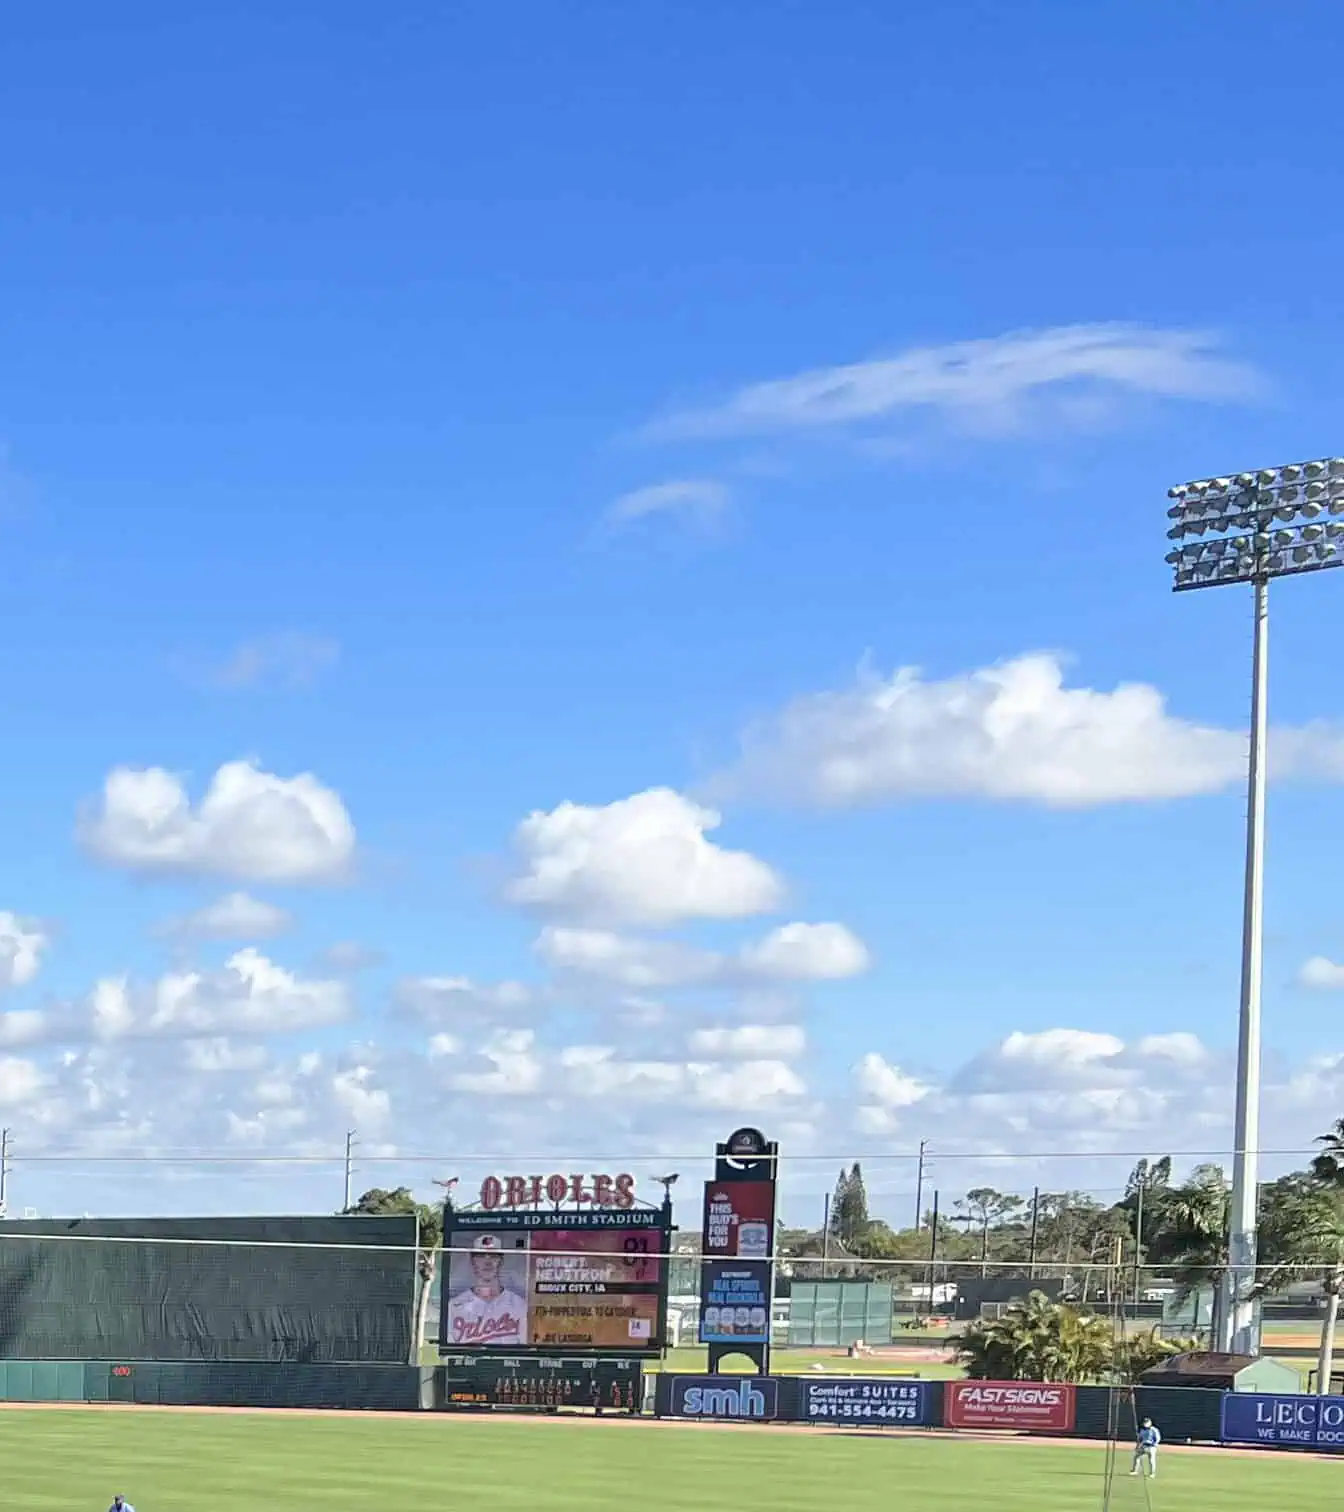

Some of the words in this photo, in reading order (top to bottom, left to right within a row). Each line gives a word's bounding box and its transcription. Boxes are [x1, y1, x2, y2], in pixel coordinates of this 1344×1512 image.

[480, 1173, 635, 1210] ORIOLES
[709, 1203, 732, 1213] THIS
[523, 1214, 541, 1225] ED
[544, 1214, 588, 1225] SMITH
[591, 1213, 655, 1225] STADIUM
[708, 1213, 739, 1225] BUD'S
[708, 1225, 729, 1236] FOR
[708, 1236, 729, 1247] YOU
[683, 1380, 765, 1416] smh
[809, 1385, 855, 1398] Comfort
[861, 1386, 918, 1399] SUITES
[958, 1387, 1062, 1404] FASTSIGNS
[809, 1404, 917, 1418] 941-554-4475
[1257, 1428, 1276, 1439] WE
[1279, 1429, 1311, 1441] MAKE
